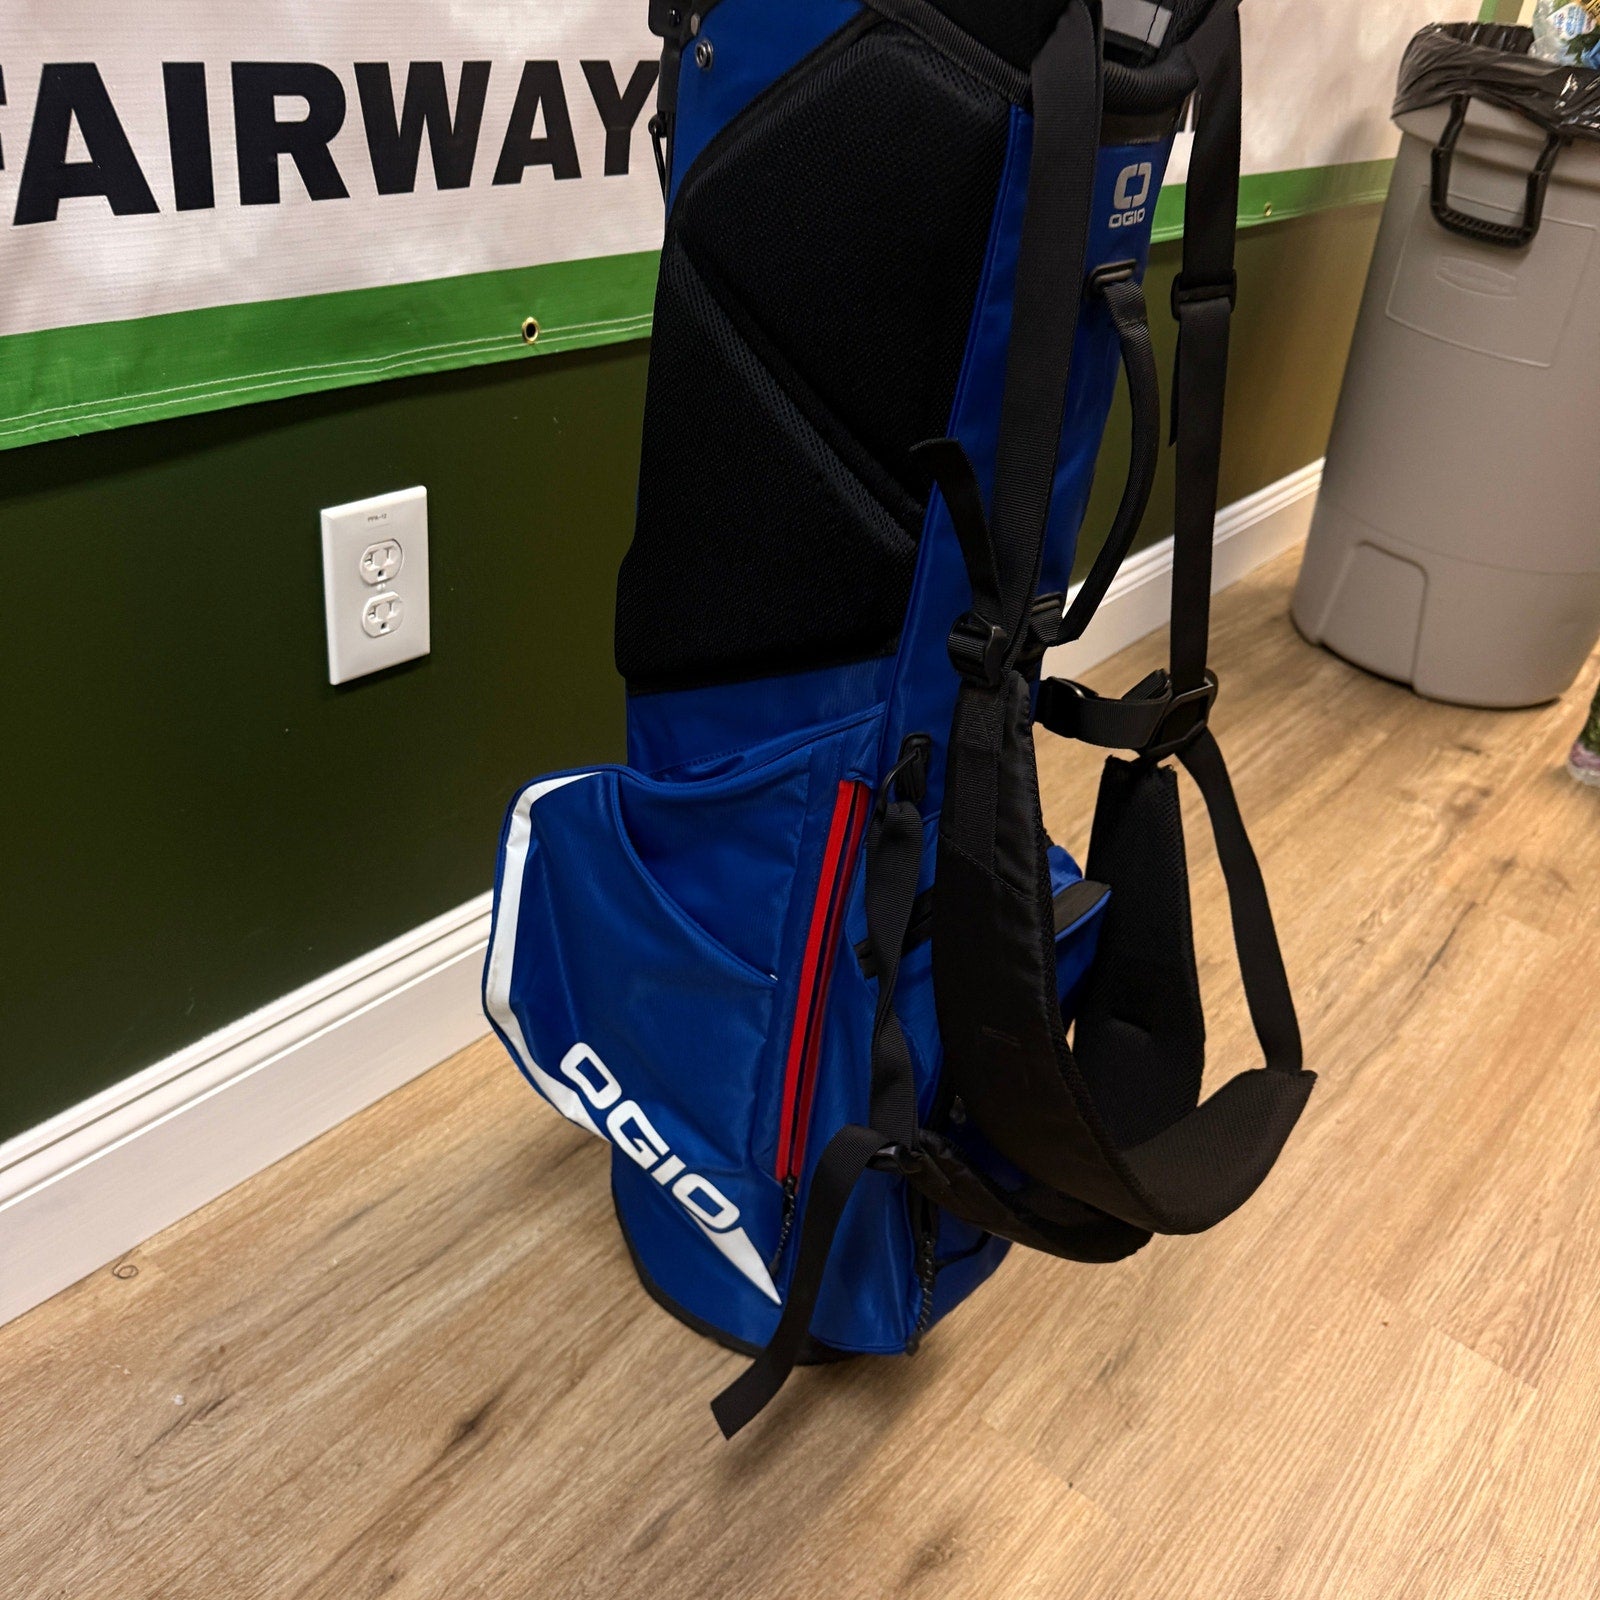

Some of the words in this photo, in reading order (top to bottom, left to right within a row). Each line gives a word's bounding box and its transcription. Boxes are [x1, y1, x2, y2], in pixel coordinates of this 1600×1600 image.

[0, 60, 660, 225] AIRWAY
[1108, 208, 1146, 229] OGIO
[560, 1042, 740, 1229] OGIO
